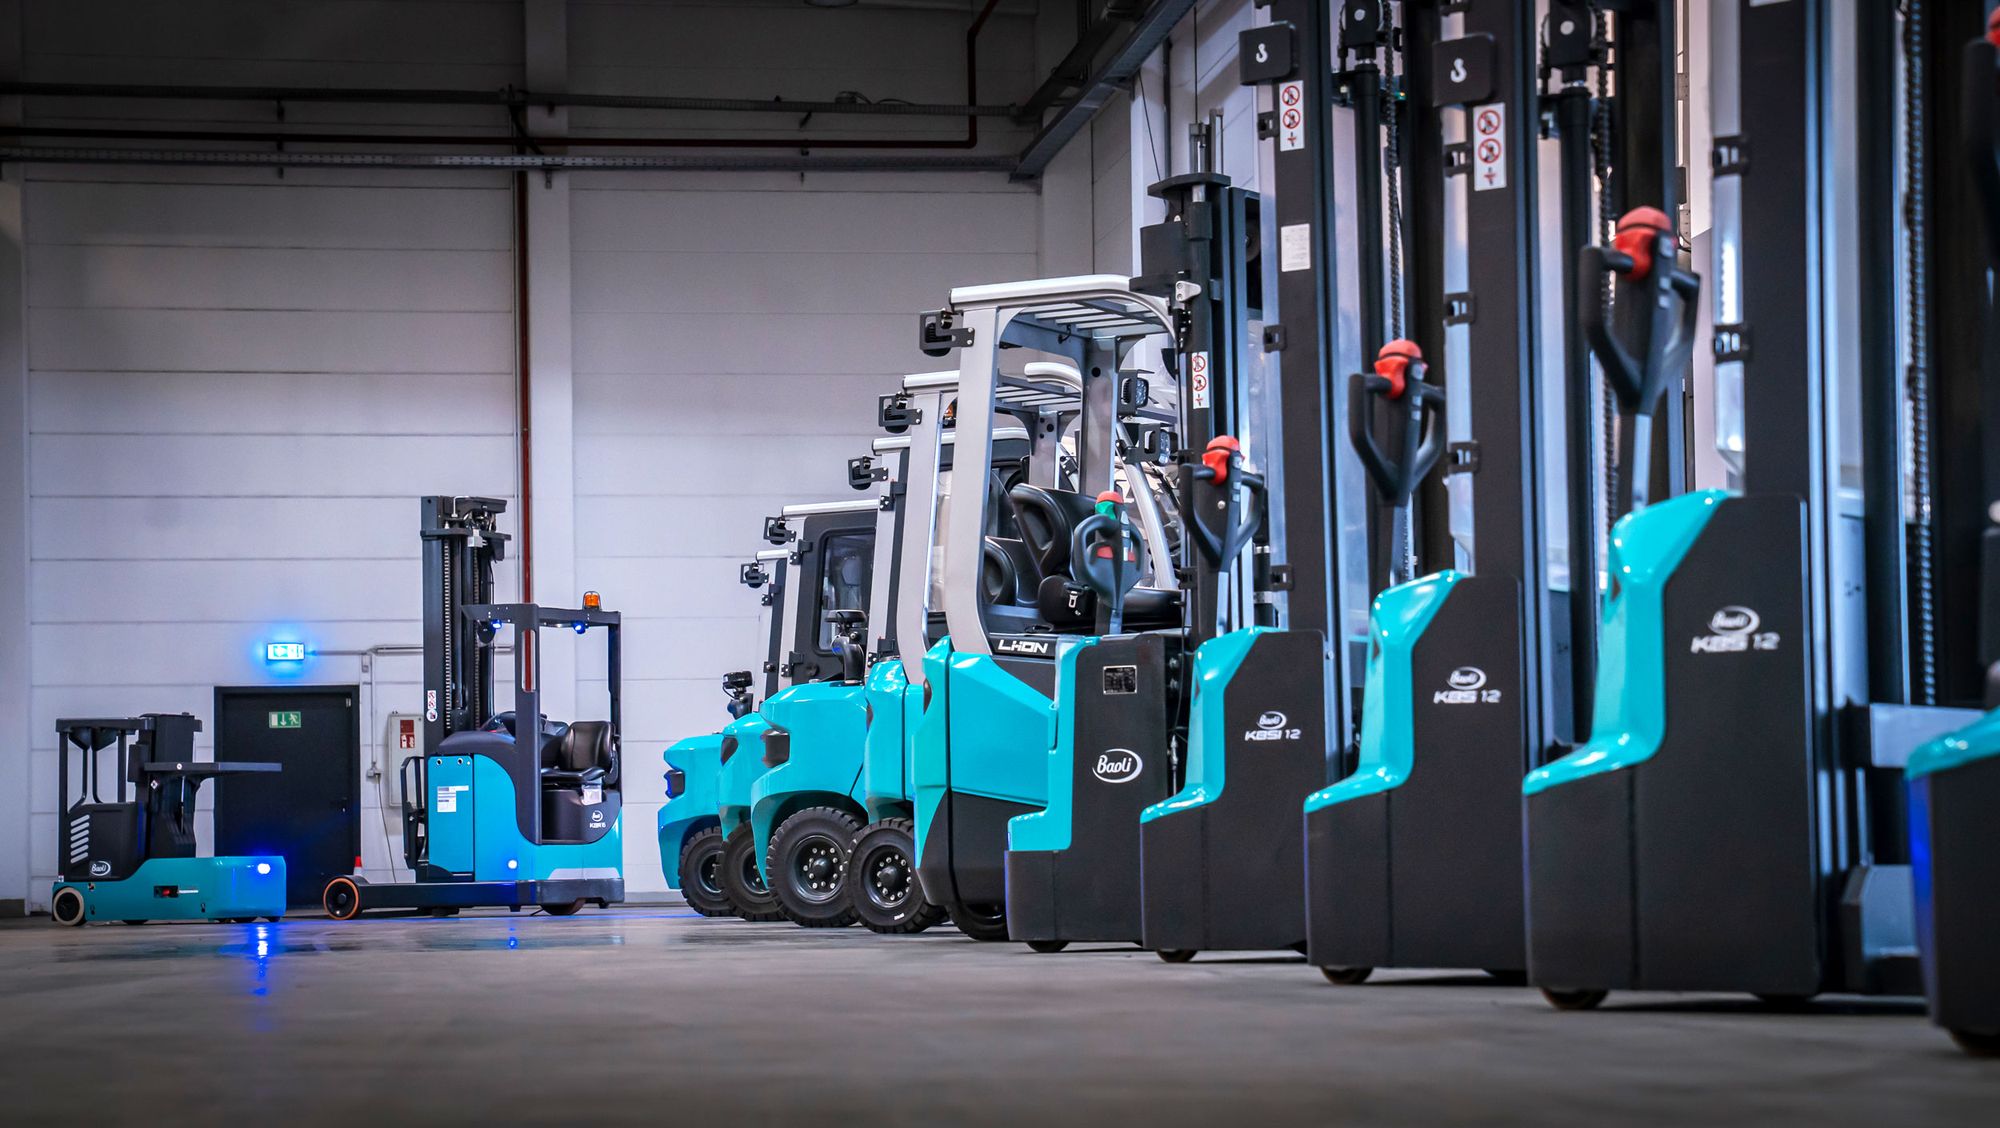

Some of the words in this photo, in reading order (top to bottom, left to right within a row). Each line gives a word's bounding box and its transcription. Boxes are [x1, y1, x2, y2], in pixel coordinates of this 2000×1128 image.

[1753, 632, 1781, 651] 12
[1481, 689, 1502, 703] 12
[1285, 728, 1302, 740] 12
[1097, 754, 1132, 774] Baoli
